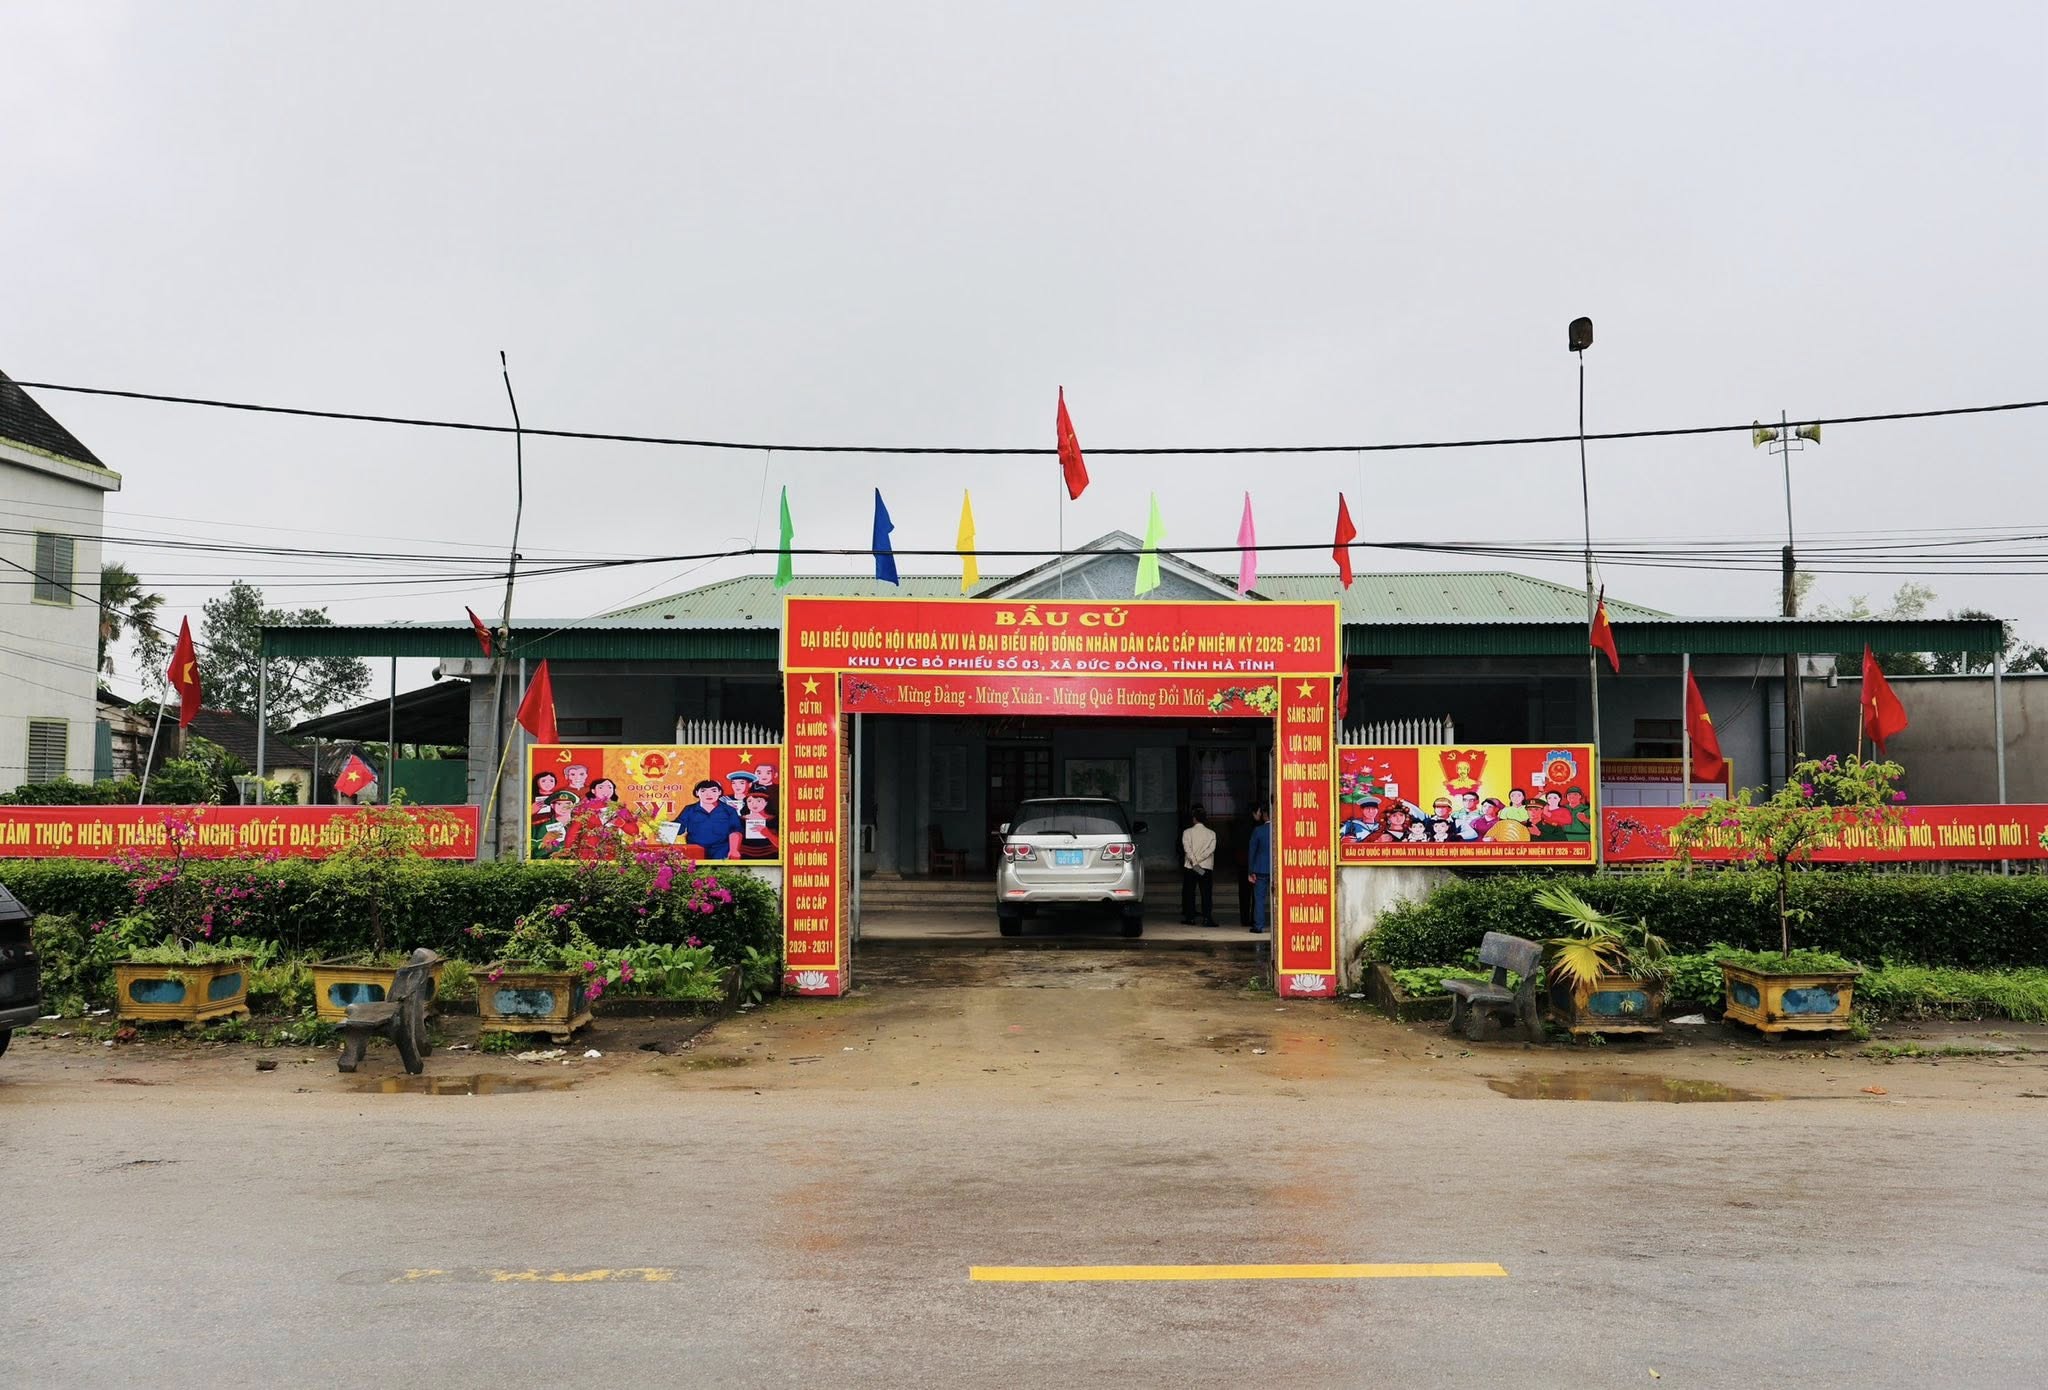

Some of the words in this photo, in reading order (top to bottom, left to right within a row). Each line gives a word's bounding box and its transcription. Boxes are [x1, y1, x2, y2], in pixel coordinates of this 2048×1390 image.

[995, 604, 1070, 627] BẦU
[1079, 607, 1128, 627] CỬ
[801, 631, 820, 648] ĐẠI
[823, 626, 849, 648] BIỂU
[852, 627, 882, 650] QUỐC
[885, 629, 904, 650] HỘI
[907, 630, 938, 650] KHOÁ
[940, 633, 959, 650] XVI
[962, 631, 976, 650] VÀ
[979, 634, 999, 654] ĐẠI
[1001, 629, 1028, 652] BIỂU
[1029, 631, 1050, 652] HỘI
[1085, 632, 1118, 652] NHÂN
[1119, 632, 1144, 652] DÂN
[1147, 632, 1170, 652] CÁC
[1173, 630, 1195, 652] CẤP
[1198, 632, 1236, 654] NHIỆM
[1239, 632, 1253, 652] KỲ
[1256, 636, 1284, 653] 2026
[1294, 636, 1321, 653] 2031
[848, 656, 880, 667] KHU
[884, 656, 917, 669] VỰC
[922, 655, 943, 667] BỎ
[948, 655, 995, 670] PHIẾU
[997, 655, 1019, 670] SỐ
[1020, 660, 1047, 670] 03,
[1048, 657, 1074, 670] XÃ
[1075, 656, 1110, 670] ĐỨC
[1115, 656, 1167, 670] ĐỒNG,
[1172, 658, 1207, 670] TỈNH
[1213, 658, 1234, 670] HÀ
[1239, 659, 1274, 670] TĨNH
[799, 698, 811, 714] CỬ
[811, 702, 822, 714] TRI
[898, 686, 931, 705] Mừng
[934, 685, 965, 706] Đảng
[976, 687, 1009, 706] Mừng
[1012, 687, 1043, 705] Xuân
[1053, 687, 1087, 708] Mừng
[1090, 688, 1113, 706] Quê
[1117, 687, 1156, 709] Hương
[1159, 685, 1179, 705] Đổi
[1183, 688, 1205, 706] Mới
[1287, 704, 1305, 723] SÁNG
[1307, 702, 1324, 723] SUỐT
[796, 719, 806, 736] CẢ
[807, 721, 827, 736] NƯỚC
[795, 743, 813, 757] TÍCH
[813, 744, 827, 760] CỰC
[1289, 734, 1302, 755] LỰA
[1303, 735, 1321, 755] CHỌN
[794, 765, 814, 778] THAM
[816, 765, 828, 778] GIA
[633, 800, 676, 814] XVI
[0, 819, 31, 845] TÂM
[35, 821, 73, 849] THỰC
[78, 819, 113, 850] HIỆN
[118, 816, 166, 845] THẮNG
[199, 823, 235, 851] NGHỊ
[290, 823, 315, 850] ĐẠI
[790, 828, 809, 845] QUỐC
[811, 829, 823, 846] HỘI
[1910, 819, 1936, 848] MỚI,
[1938, 817, 1976, 847] THẮNG
[1979, 824, 1997, 851] LỢI
[2000, 818, 2021, 847] MỚI
[2025, 825, 2030, 846] !
[794, 850, 806, 868] HỘI
[1298, 844, 1316, 868] QUỐC
[1317, 847, 1329, 869] HỘI
[793, 873, 813, 887] NHÂN
[814, 873, 829, 887] DÂN
[1296, 875, 1307, 897] HỘI
[796, 894, 810, 909] CÁC
[1290, 903, 1308, 923] NHÂN
[1310, 903, 1323, 923] DÂN
[794, 916, 820, 934] NHIỆM
[789, 941, 806, 953] 2026
[813, 941, 832, 953] 2031!
[1291, 933, 1305, 952] CÁC
